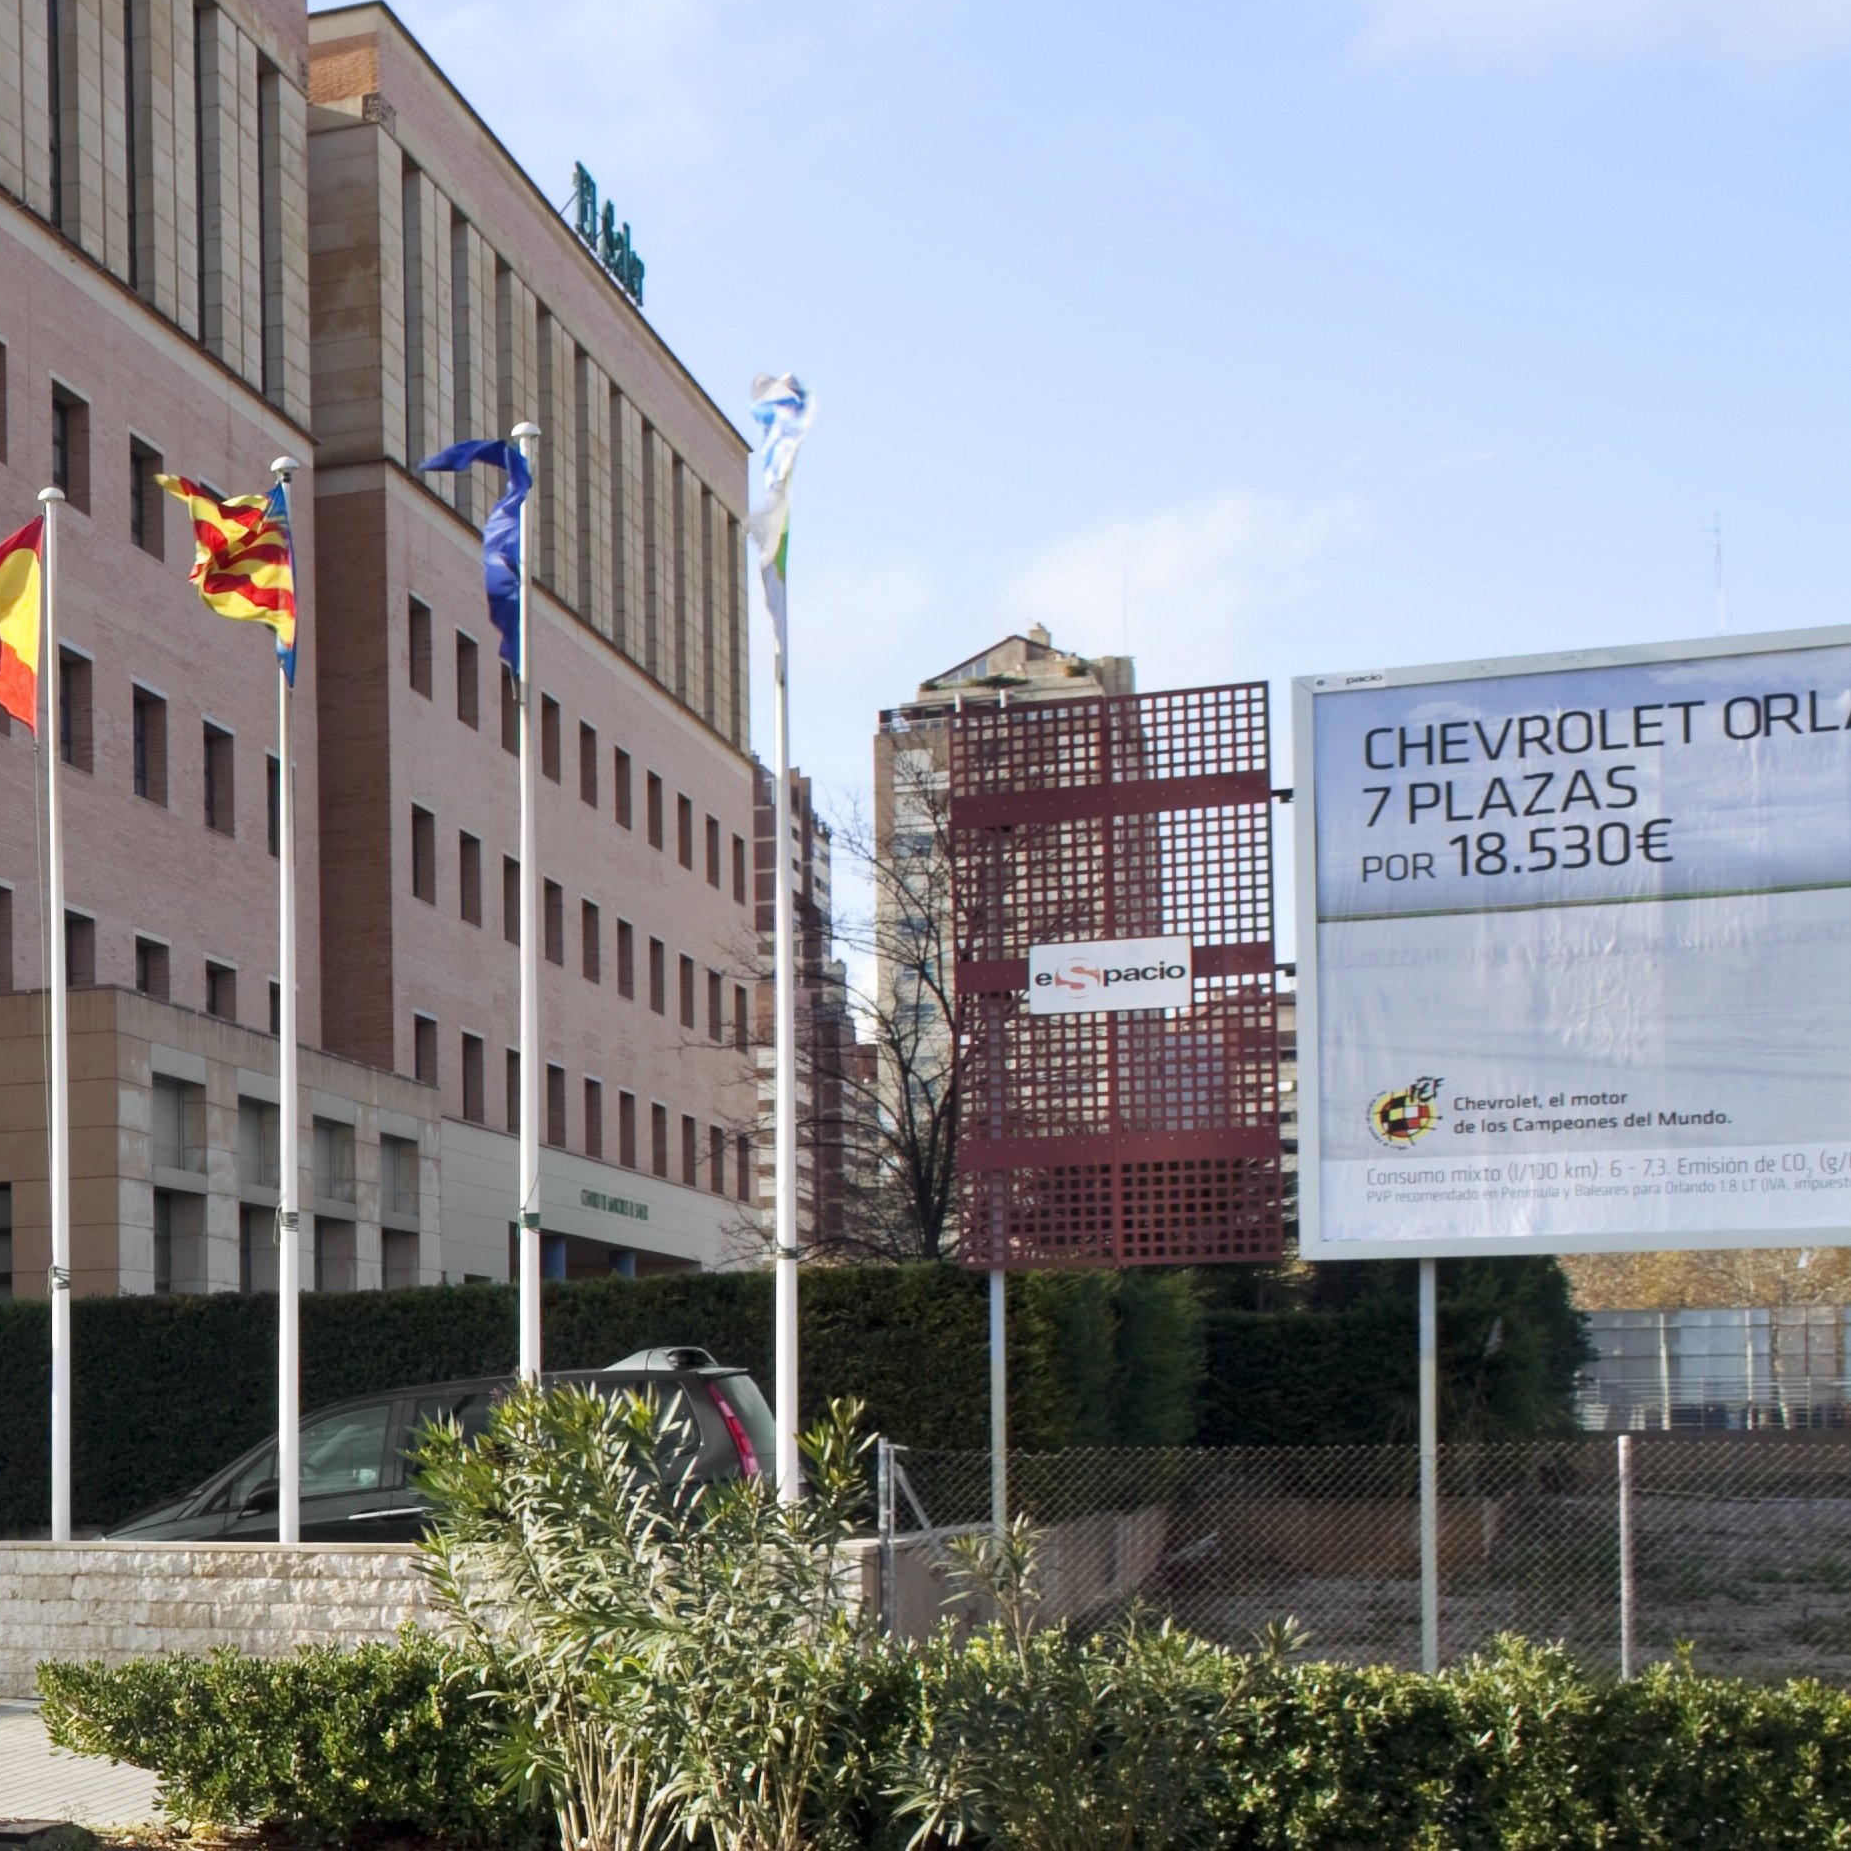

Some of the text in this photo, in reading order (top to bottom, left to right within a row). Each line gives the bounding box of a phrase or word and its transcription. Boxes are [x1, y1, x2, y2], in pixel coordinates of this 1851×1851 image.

[1364, 689, 1851, 770] CHEVROLET ORL
[1362, 765, 1638, 828] 7 PLAZAS
[1362, 818, 1674, 883] POR 18.530€
[1453, 1092, 1629, 1111] Chevrolet, el motor
[1453, 1110, 1733, 1134] de los Campeones del Mundo.
[1367, 1168, 1445, 1186] Consumo
[1450, 1164, 1501, 1182] mixto
[1610, 1159, 1622, 1178] 6
[1677, 1156, 1748, 1175] Emisión
[1755, 1155, 1776, 1173] de
[1367, 1190, 1391, 1204] PVP
[1395, 1188, 1479, 1203] recomendado
[1563, 1187, 1570, 1200] y
[1575, 1181, 1629, 1198] Baleares
[1632, 1183, 1661, 1199] para
[1665, 1180, 1715, 1194] Orlando
[1741, 1178, 1756, 1193] LT
[1794, 1176, 1851, 1192] impuest
